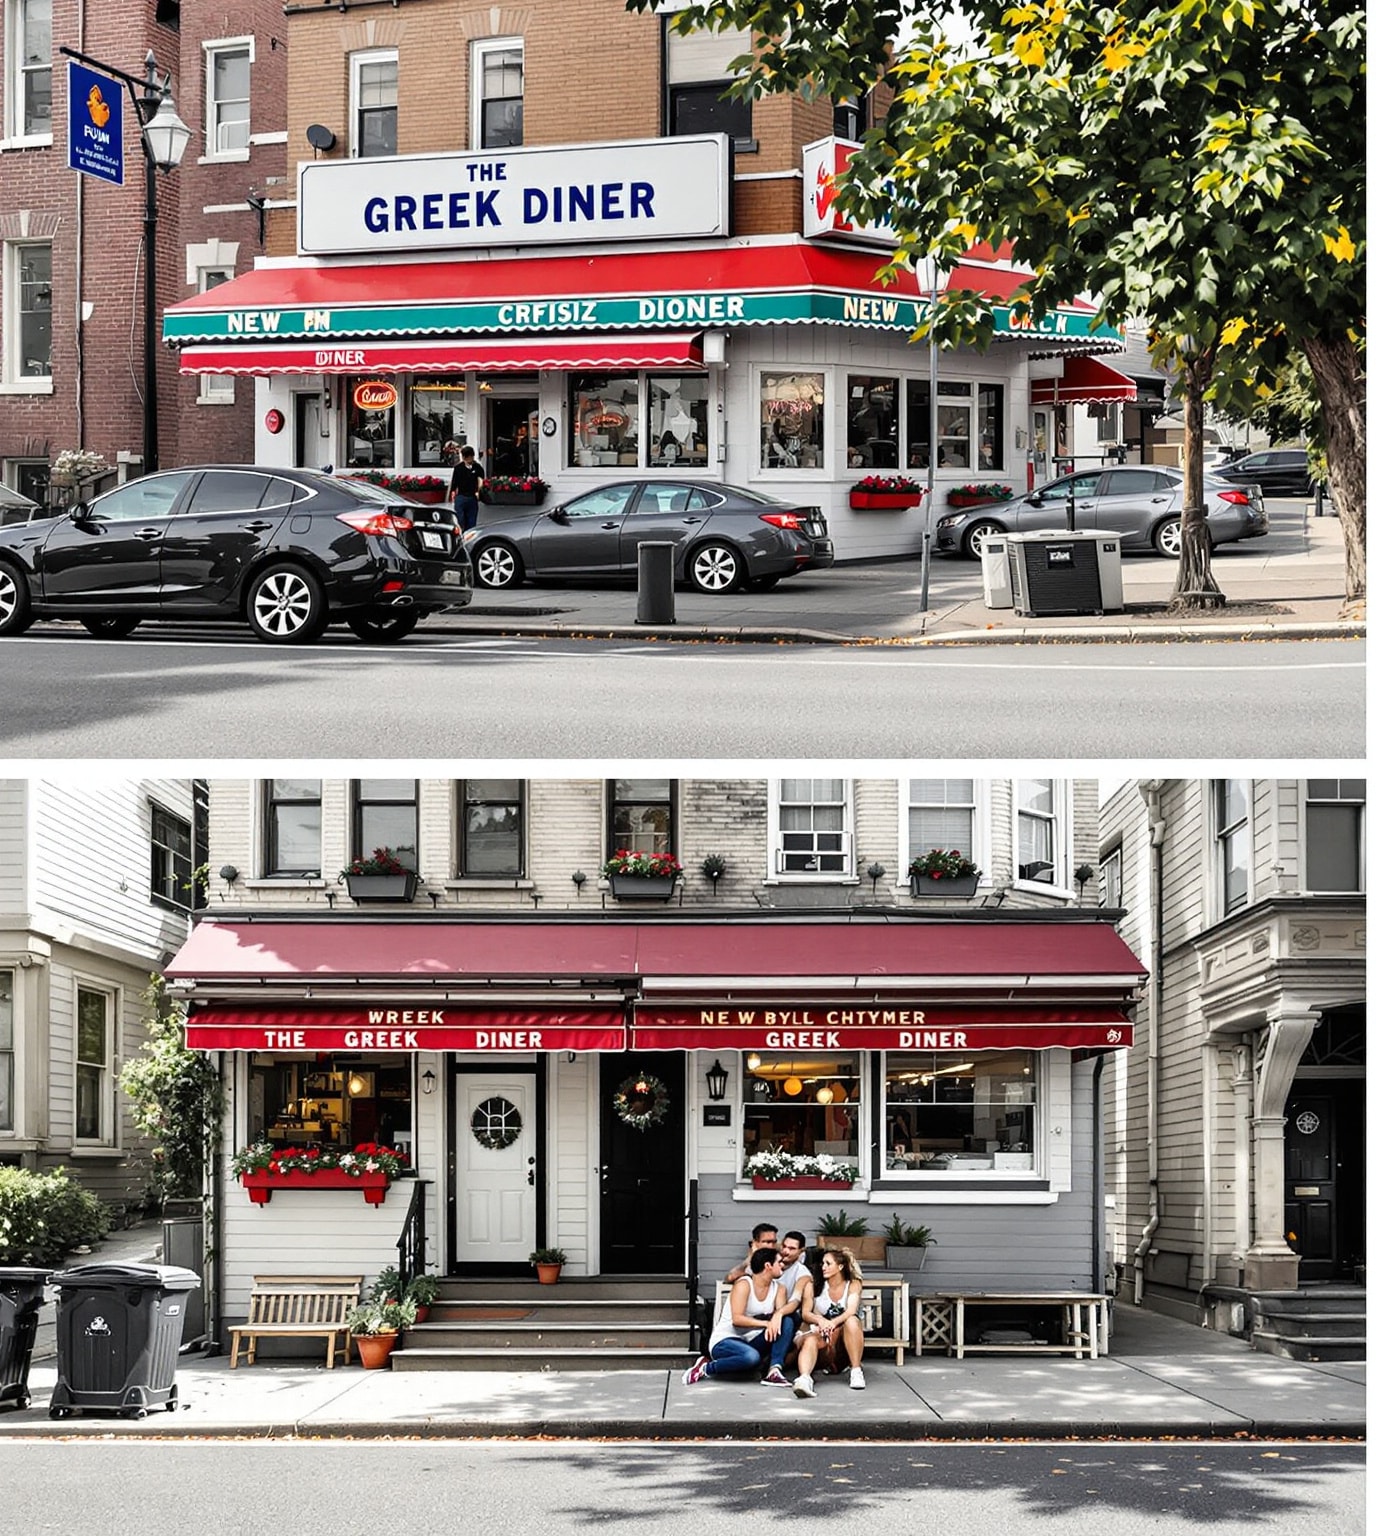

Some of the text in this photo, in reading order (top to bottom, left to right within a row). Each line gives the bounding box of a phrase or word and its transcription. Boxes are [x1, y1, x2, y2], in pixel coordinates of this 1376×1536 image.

[466, 163, 507, 182] THE
[364, 182, 656, 233] GREEK DINER
[228, 311, 281, 332] NEW
[638, 296, 744, 321] DIONER
[843, 296, 899, 322] NEEW
[315, 350, 366, 366] DINER
[368, 1010, 445, 1025] WREEK
[827, 1011, 926, 1025] CHTYMER
[264, 1031, 543, 1048] THE GREEK DINER
[766, 1031, 968, 1048] GREEK DINER
